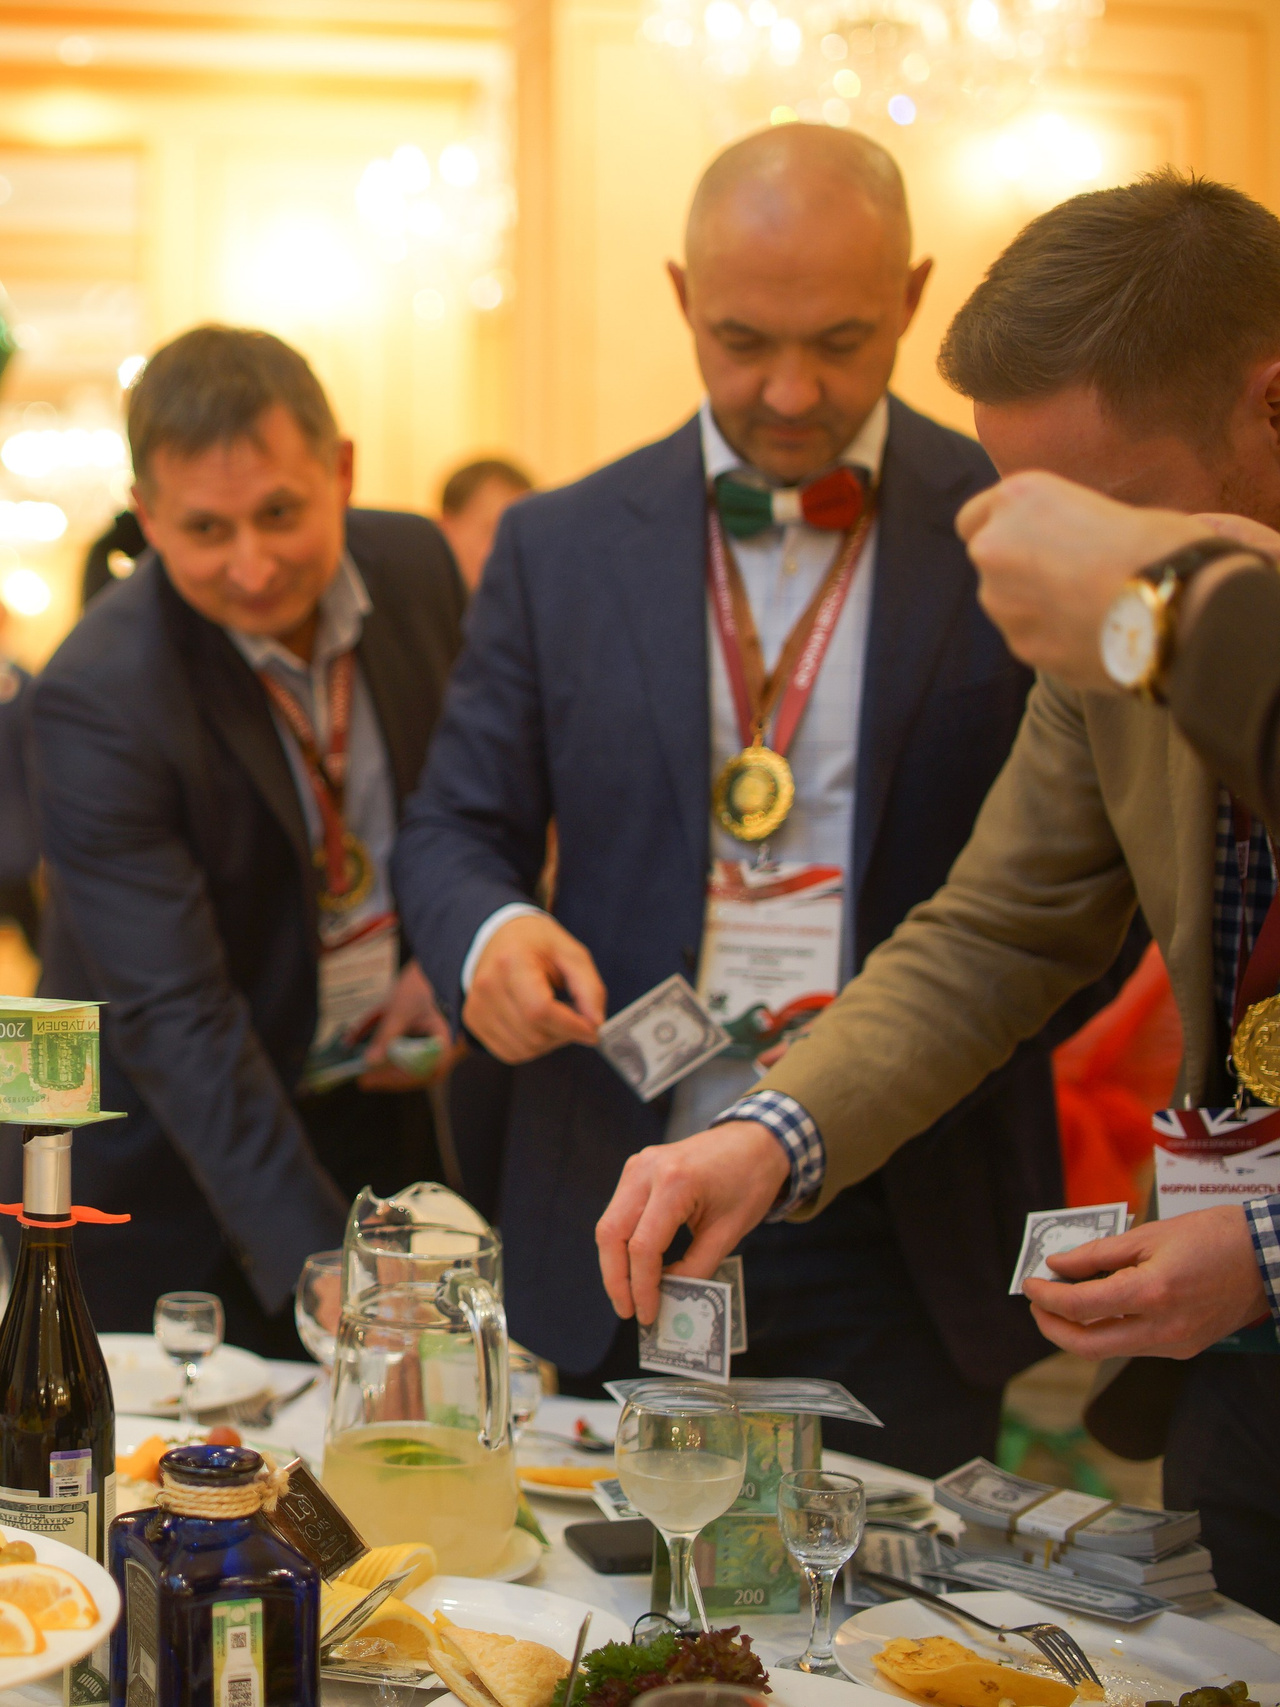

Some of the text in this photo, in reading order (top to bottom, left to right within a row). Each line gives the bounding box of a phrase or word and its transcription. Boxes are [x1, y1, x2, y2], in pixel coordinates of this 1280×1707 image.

[36, 1019, 85, 1033] ДУБЛЕЙ
[1161, 1184, 1197, 1195] ФОРУМ
[1199, 1184, 1275, 1195] БЕЗОПАСНОСТЬ
[733, 1588, 765, 1605] 200
